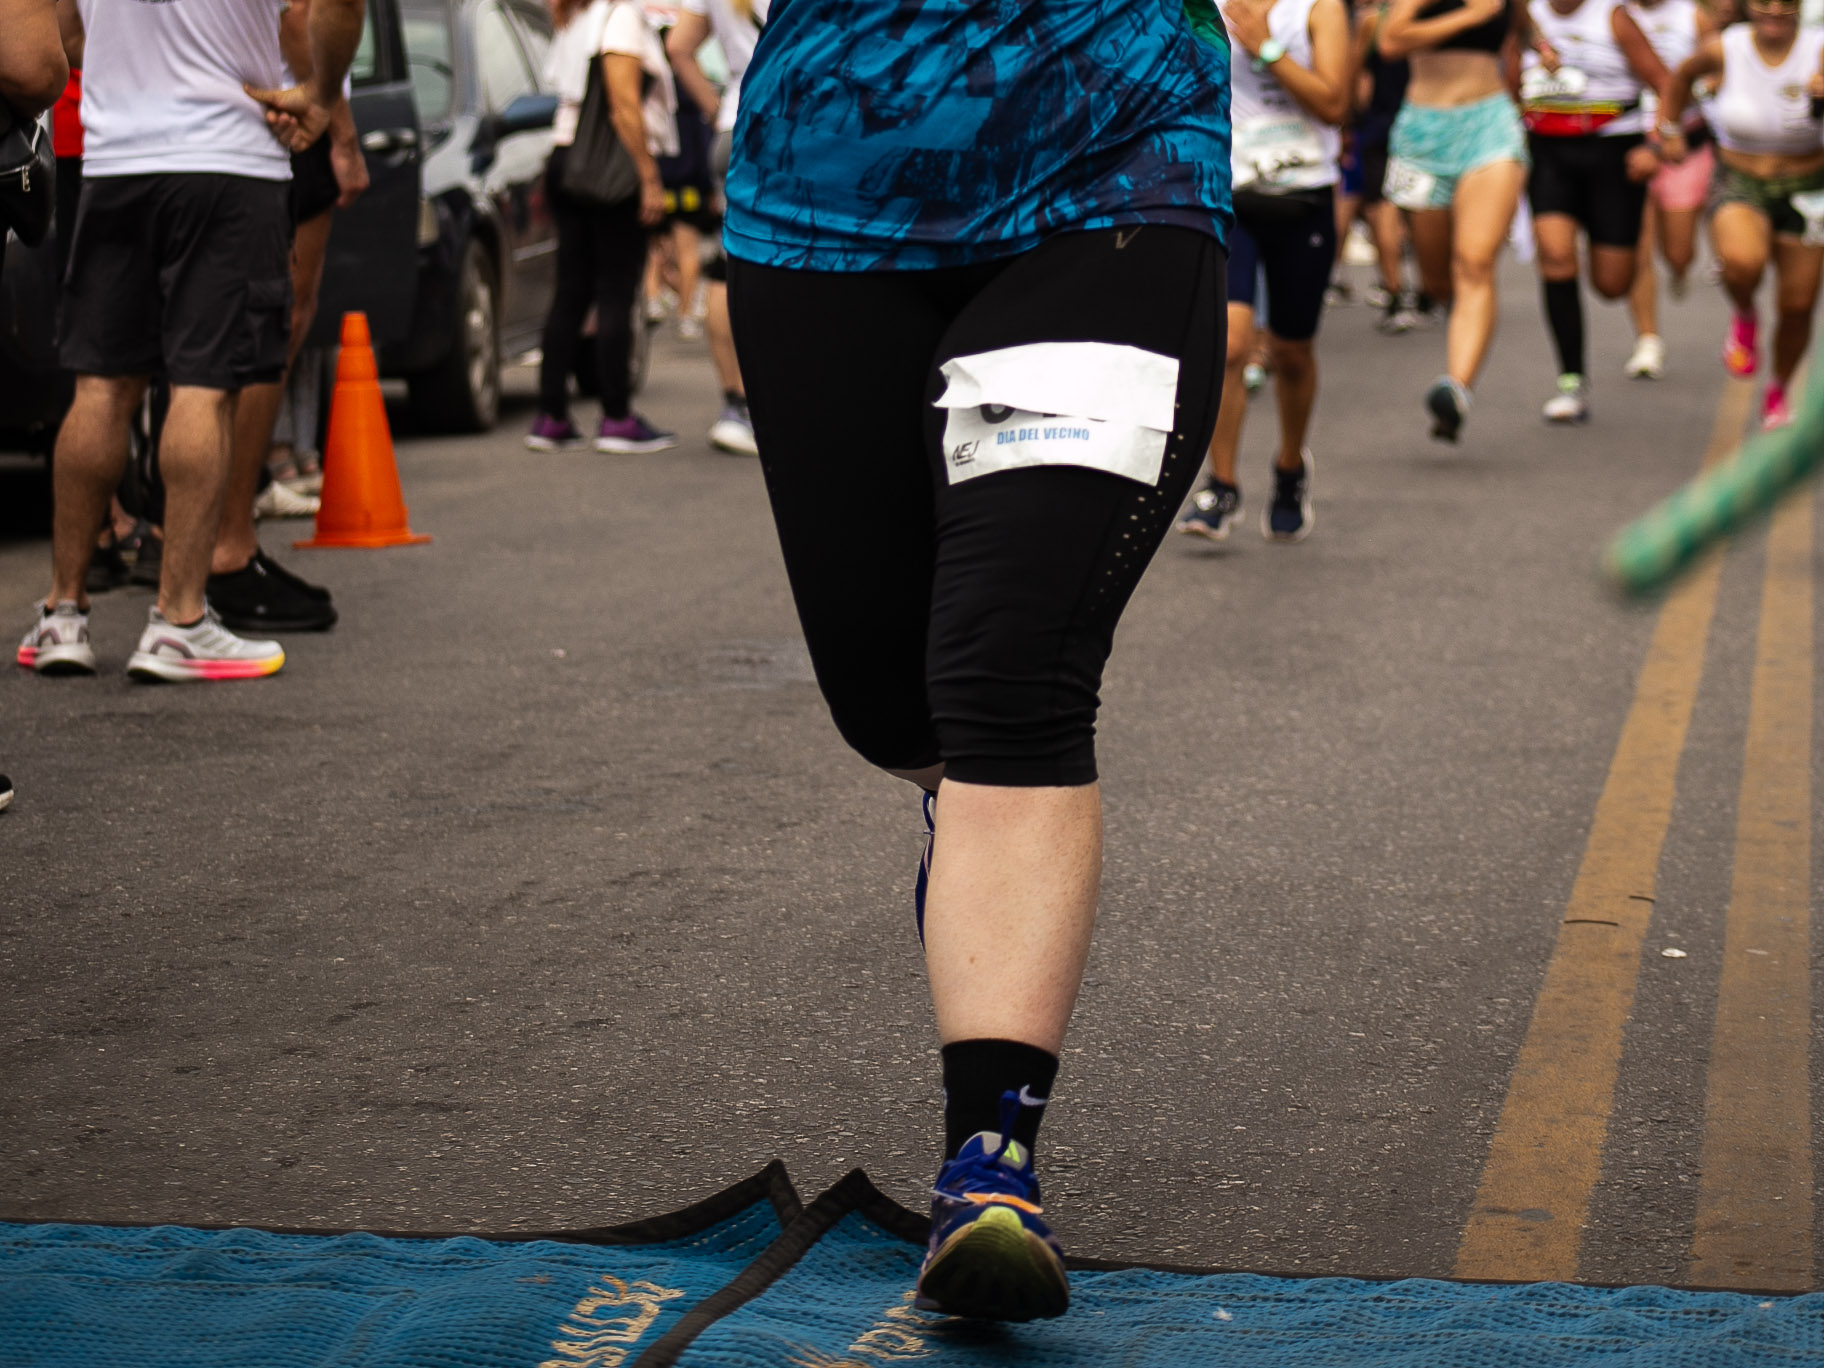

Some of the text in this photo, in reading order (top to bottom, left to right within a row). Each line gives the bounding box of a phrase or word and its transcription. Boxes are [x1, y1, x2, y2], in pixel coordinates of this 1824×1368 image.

[997, 427, 1091, 445] DIA DEL VECINO
